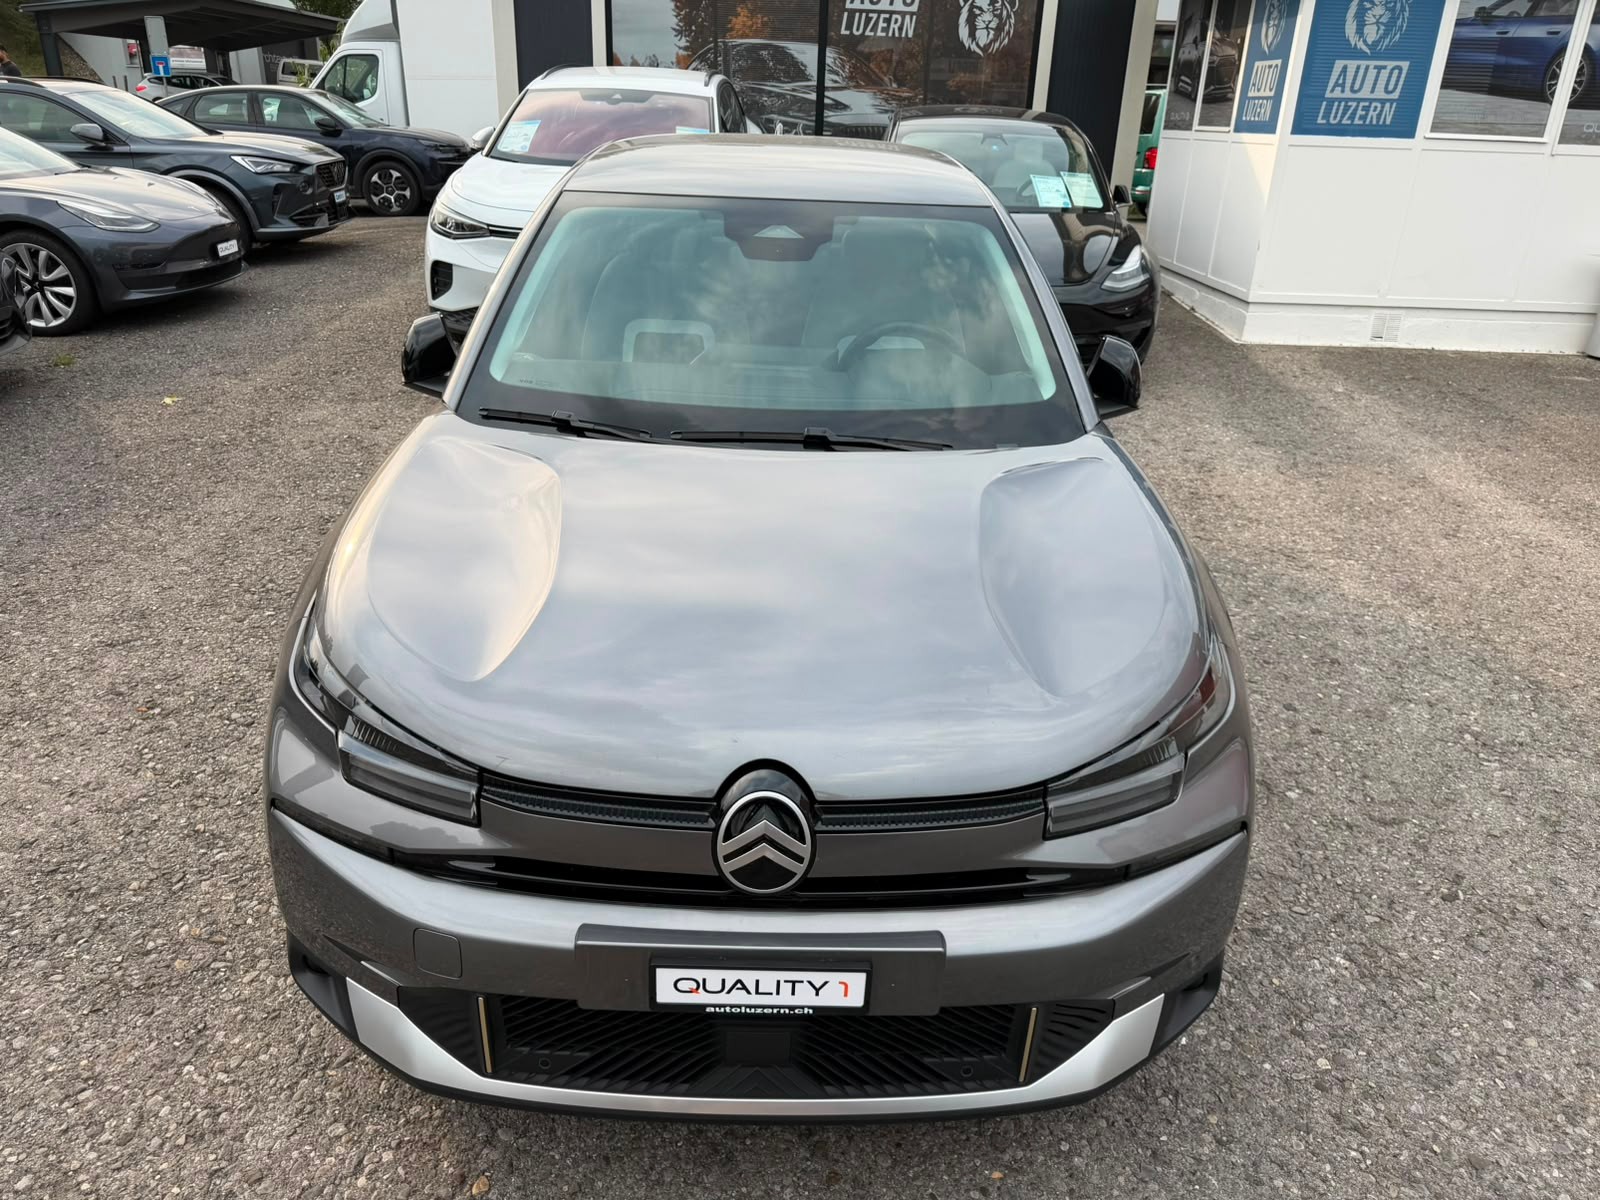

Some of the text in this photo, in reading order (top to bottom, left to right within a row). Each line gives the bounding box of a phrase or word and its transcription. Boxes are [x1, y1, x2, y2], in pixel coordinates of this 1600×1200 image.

[840, 11, 917, 38] LUZERN
[1250, 63, 1279, 94] AUTO
[1329, 63, 1404, 95] AUTO
[1242, 99, 1273, 122] LUZERN
[1316, 101, 1396, 125] LUZERN
[673, 977, 849, 998] QUALITY 1
[705, 1006, 813, 1014] autoluzern.ch
